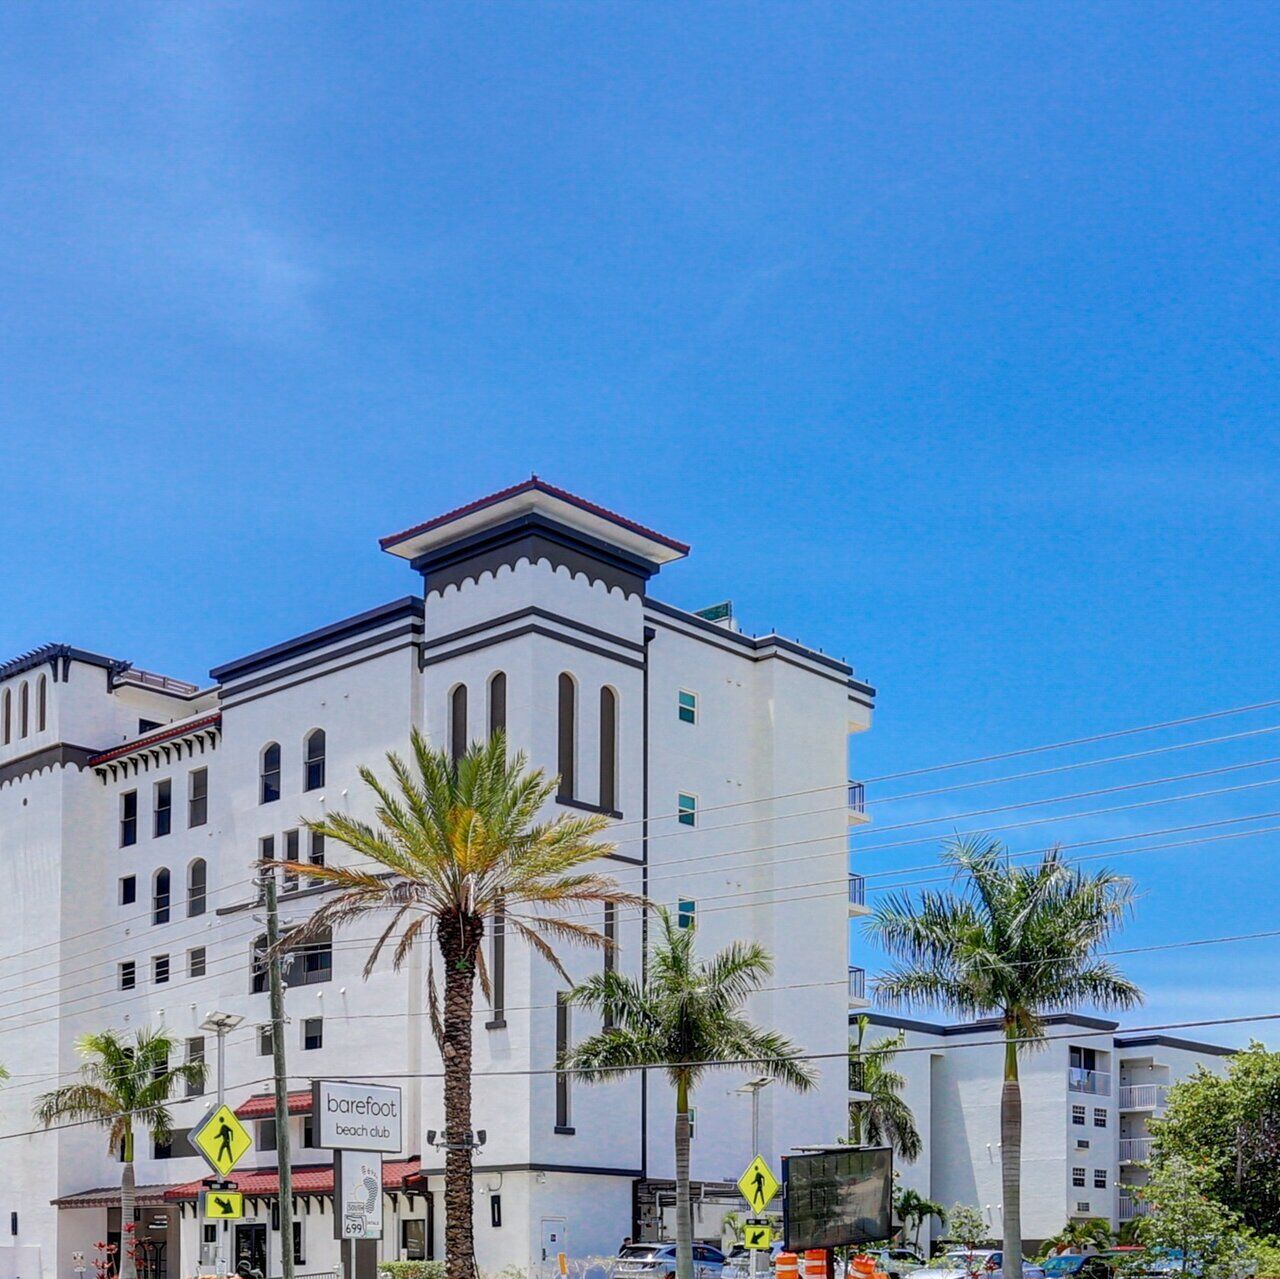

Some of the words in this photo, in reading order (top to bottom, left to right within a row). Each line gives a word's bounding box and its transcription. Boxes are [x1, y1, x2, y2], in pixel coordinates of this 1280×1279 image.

[327, 1092, 397, 1118] barefoot
[335, 1123, 368, 1137] beach
[369, 1125, 391, 1139] club
[345, 1223, 362, 1234] 699
